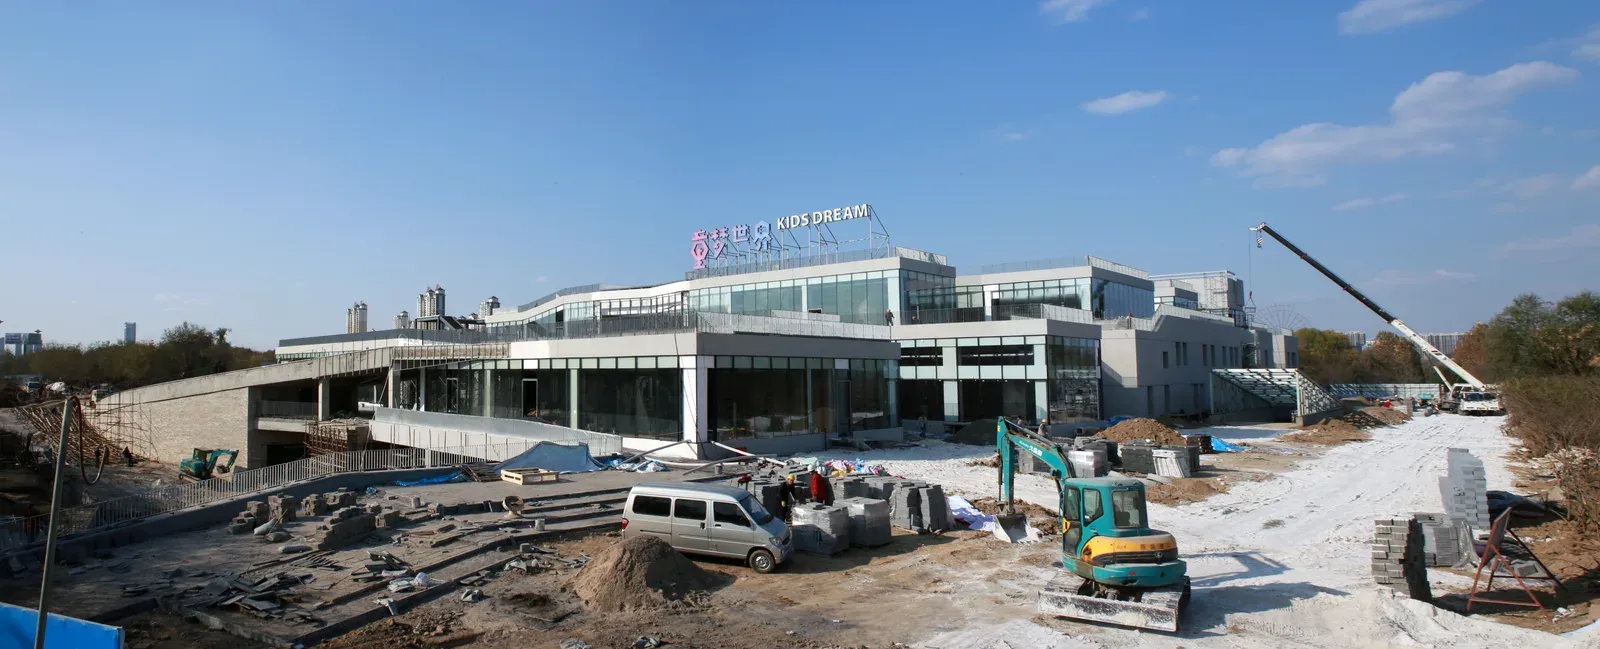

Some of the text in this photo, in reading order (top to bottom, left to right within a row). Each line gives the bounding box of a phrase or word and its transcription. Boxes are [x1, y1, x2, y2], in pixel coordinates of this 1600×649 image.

[777, 203, 869, 230] KIDS DREAM
[691, 219, 773, 270] 童梦世界
